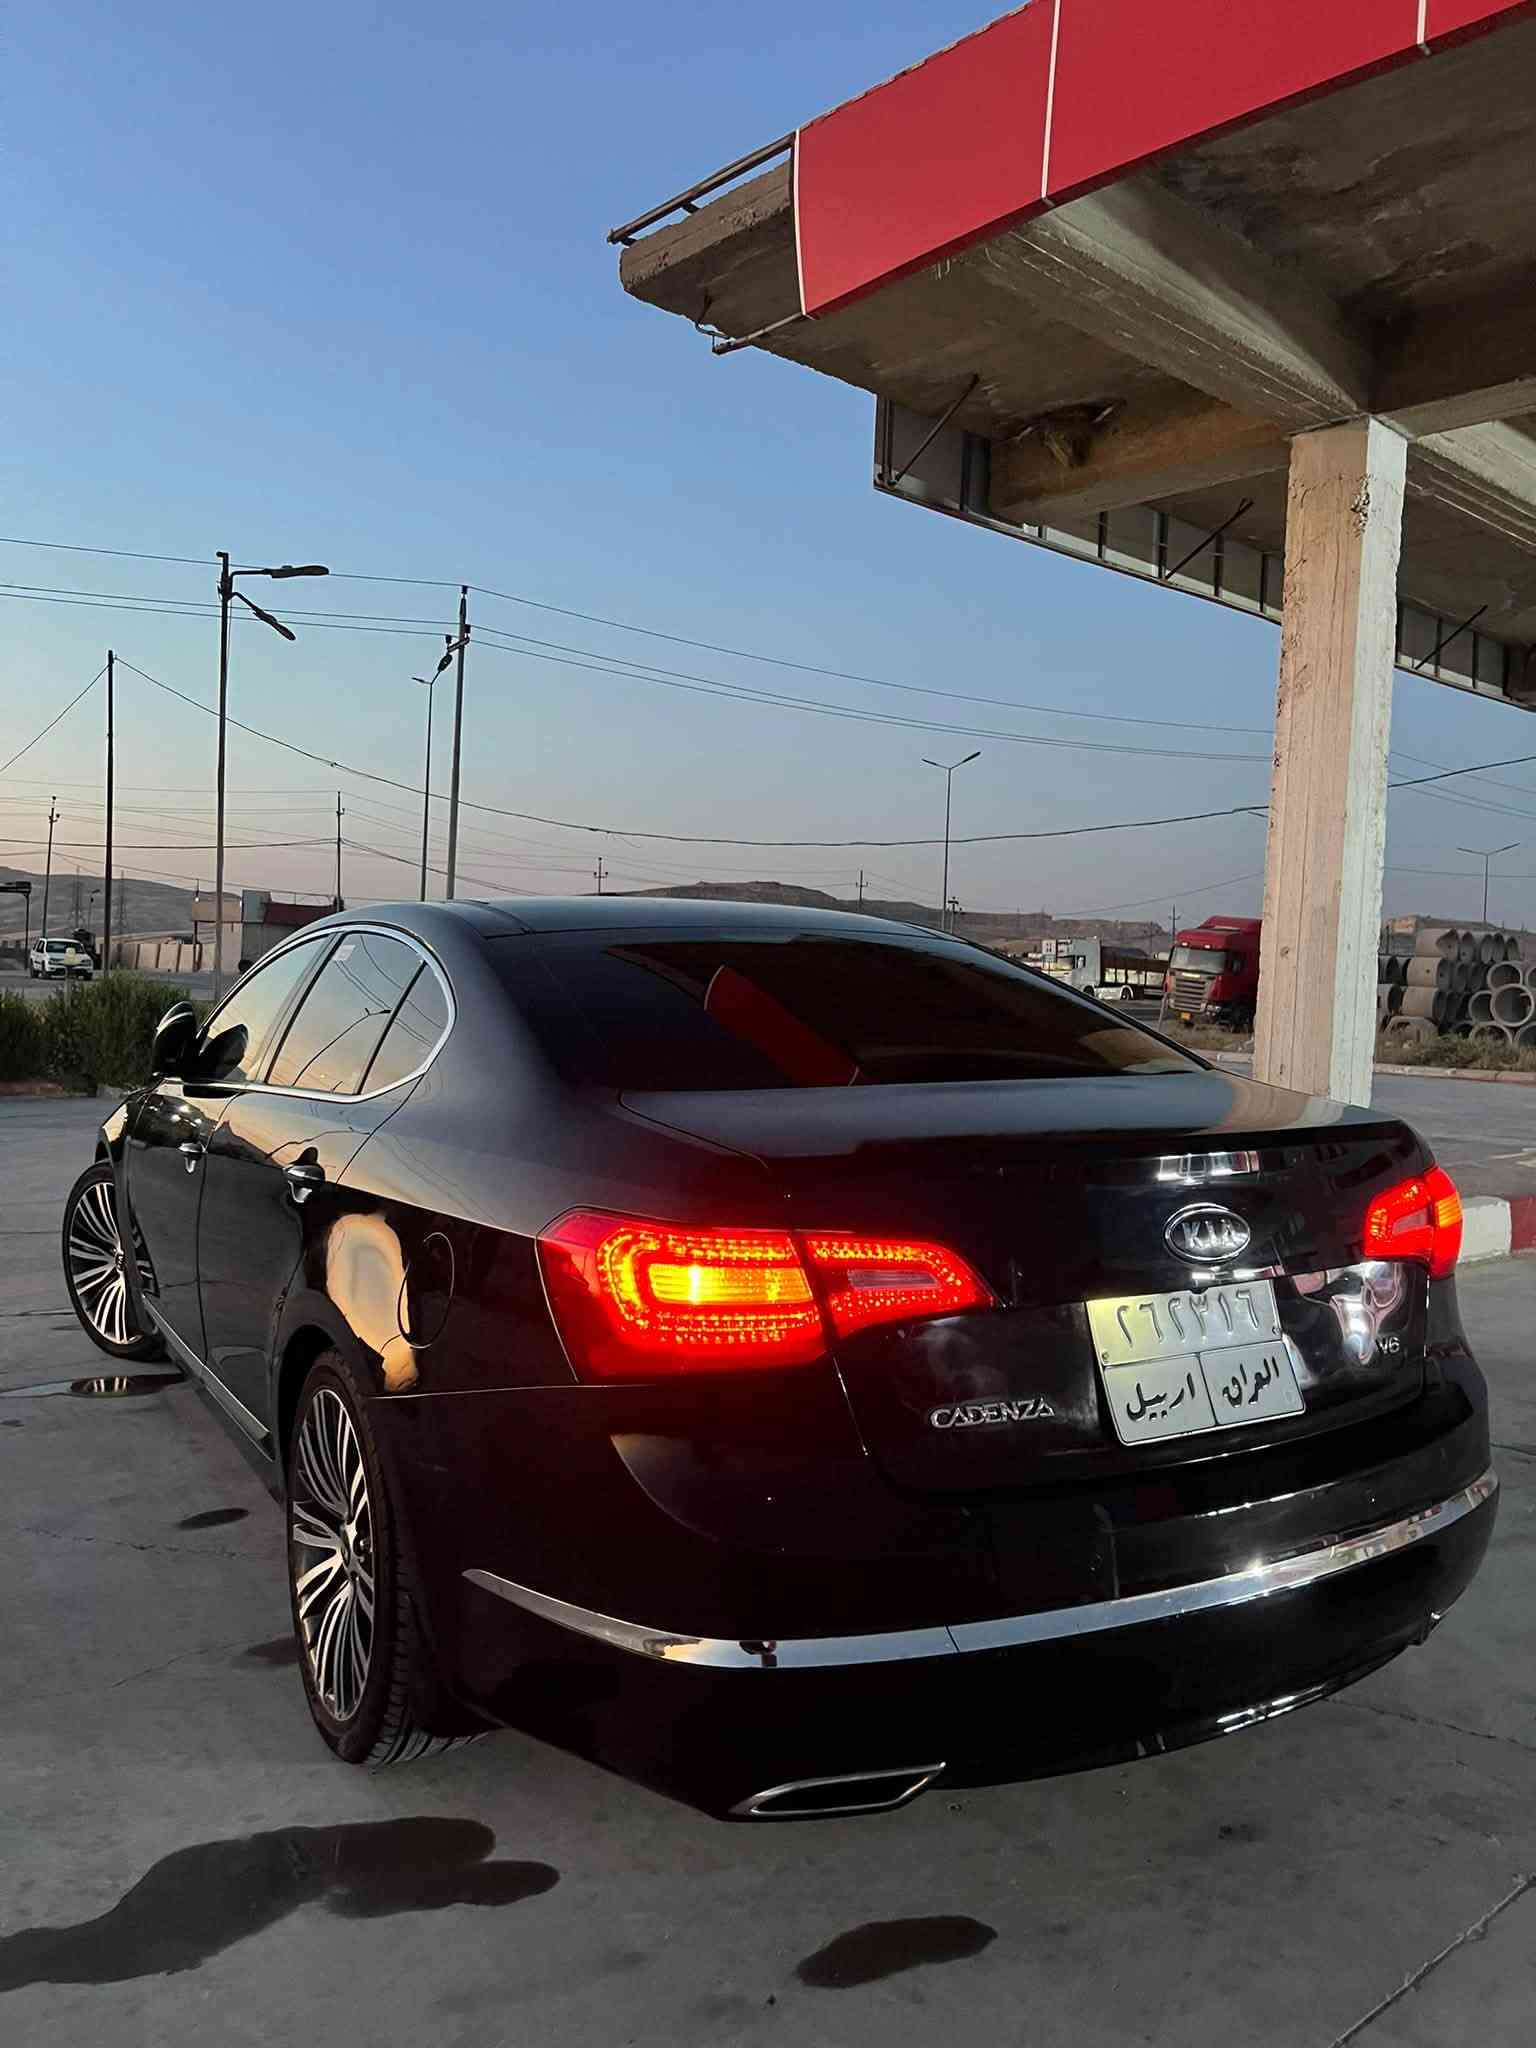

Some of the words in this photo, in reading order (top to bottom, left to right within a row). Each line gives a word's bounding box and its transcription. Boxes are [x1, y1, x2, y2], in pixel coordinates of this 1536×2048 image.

[1181, 1219, 1243, 1249] KIA
[1376, 1337, 1399, 1354] V6
[1222, 1356, 1280, 1408] العراق
[930, 1398, 1055, 1428] CADENZA
